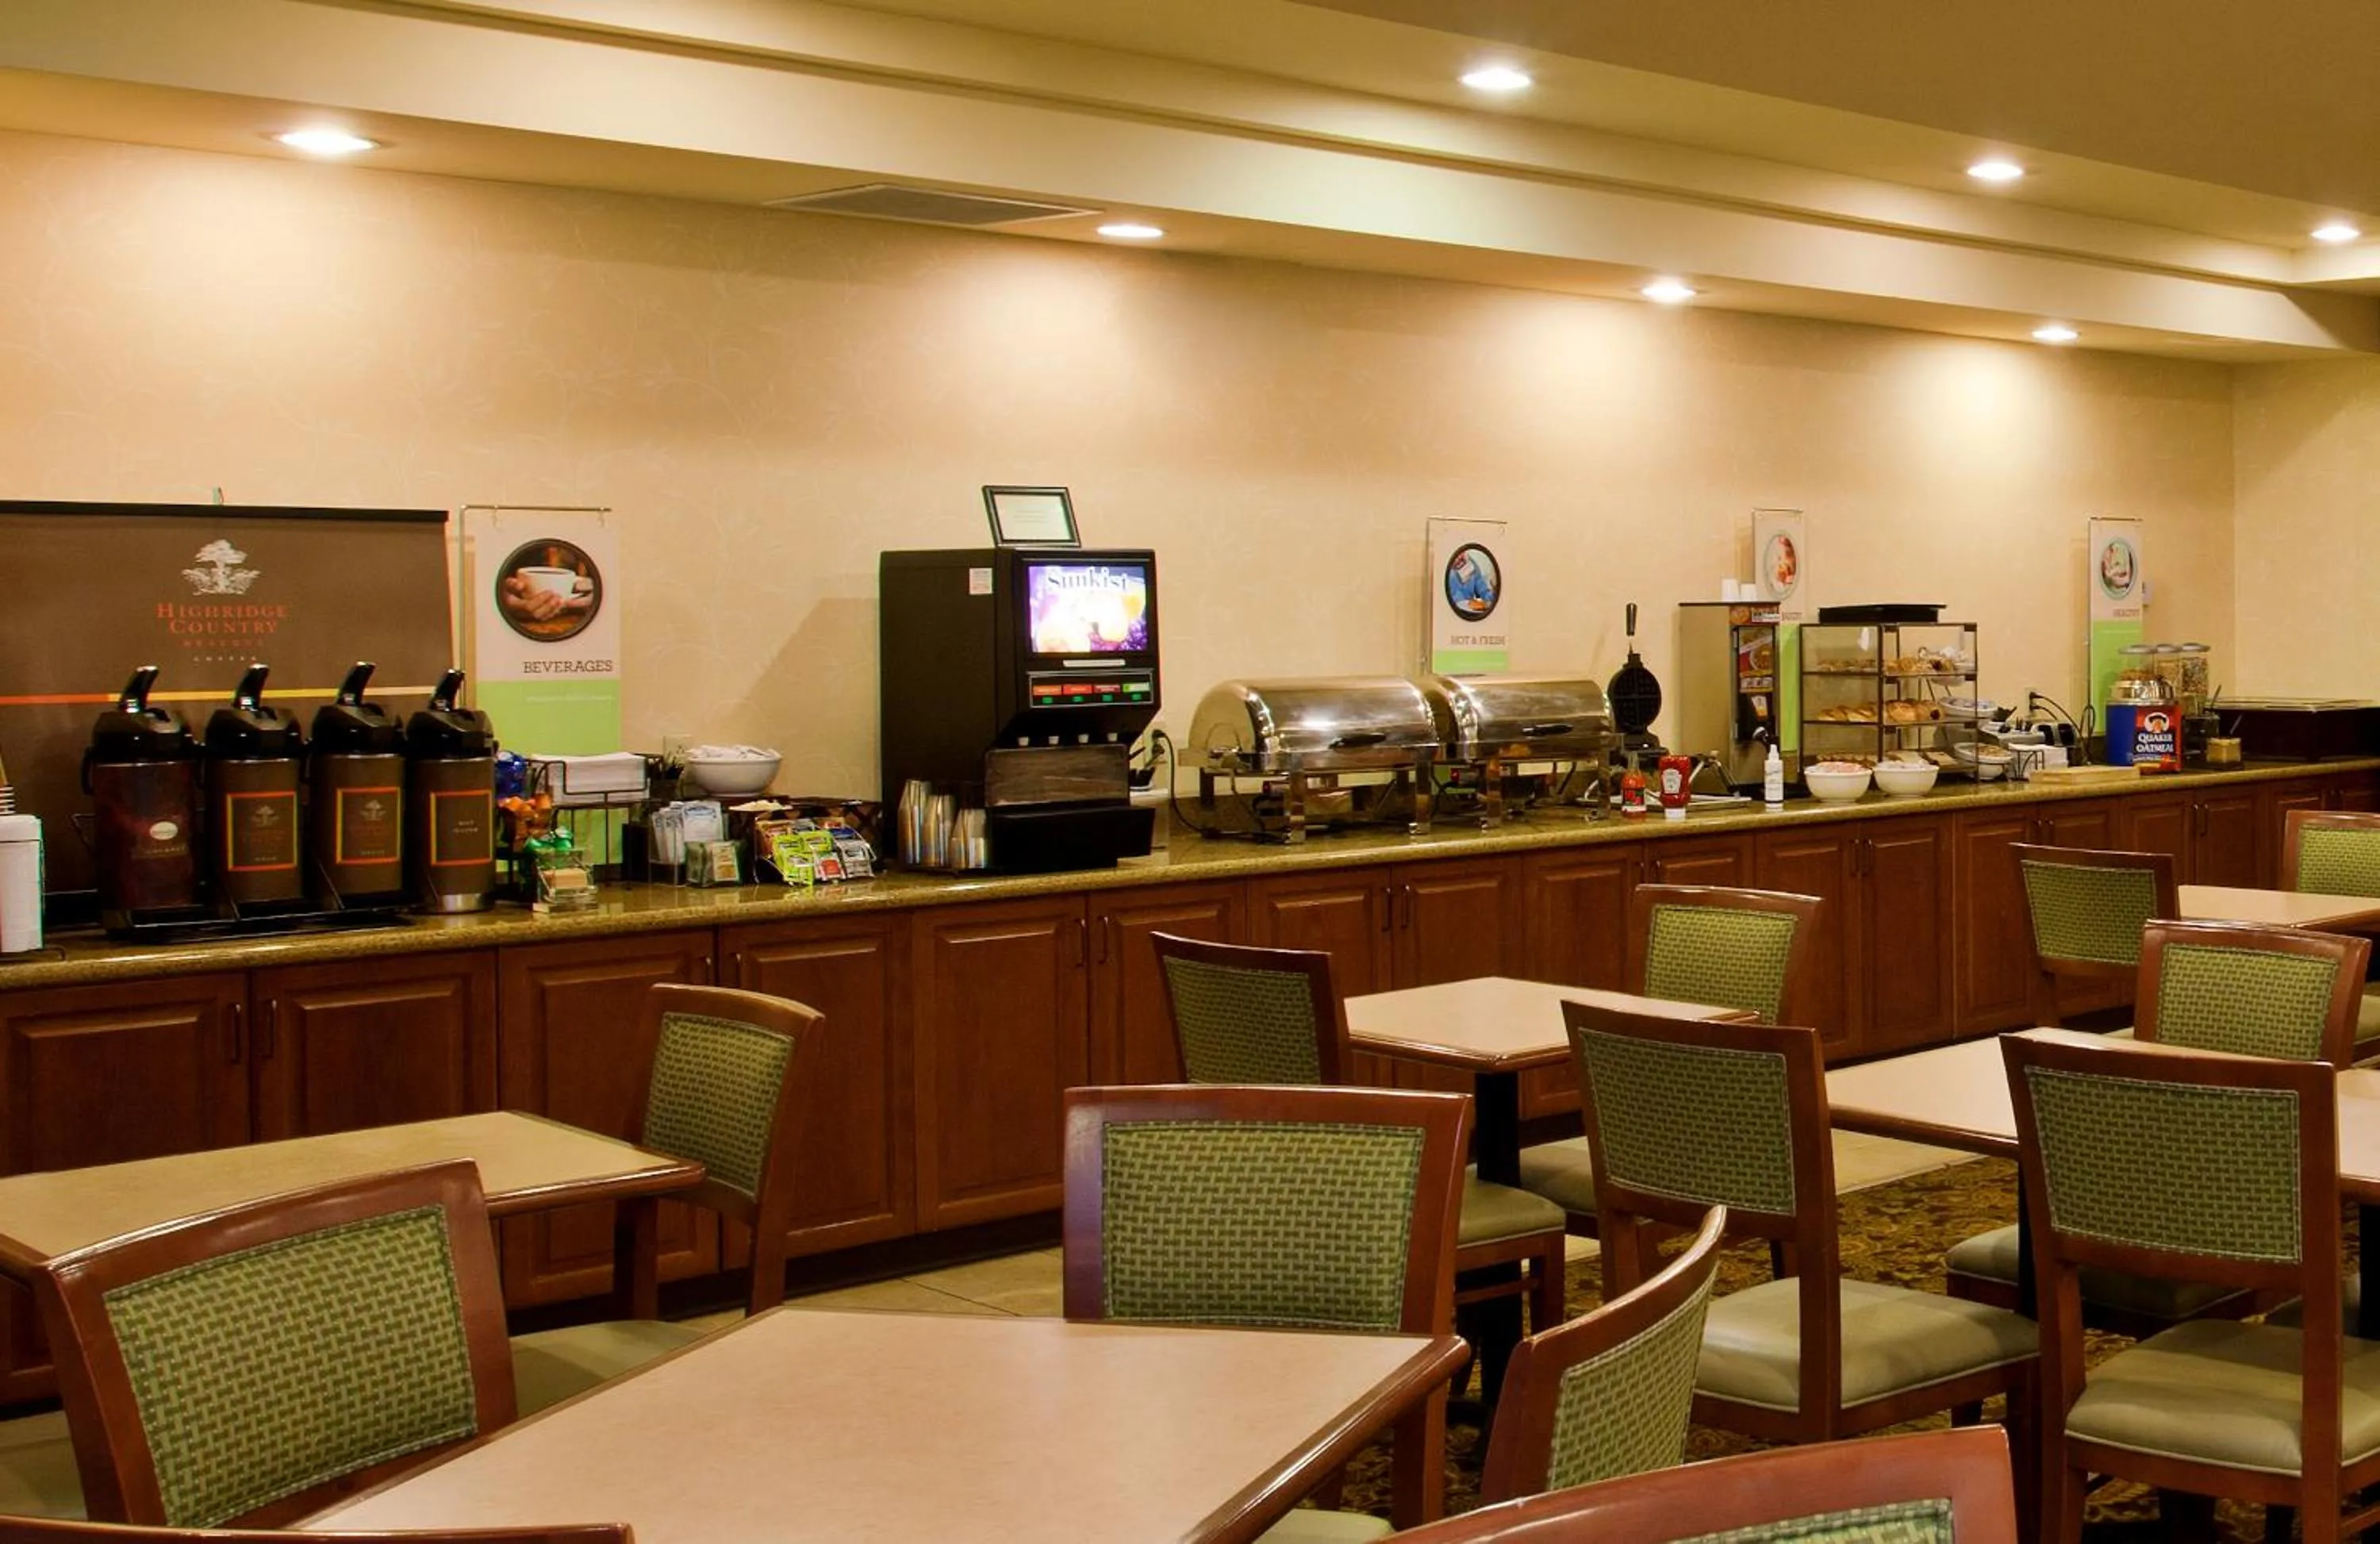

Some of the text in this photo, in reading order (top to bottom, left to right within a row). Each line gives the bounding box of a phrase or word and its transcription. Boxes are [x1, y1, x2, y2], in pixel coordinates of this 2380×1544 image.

[1047, 567, 1127, 590] Sunkist
[155, 602, 289, 619] HIGHRIDGE
[168, 619, 278, 635] COUNTRY
[523, 659, 613, 674] BEVERAGES
[2138, 732, 2174, 743] QUAKER
[2136, 743, 2174, 753] OATMEAL
